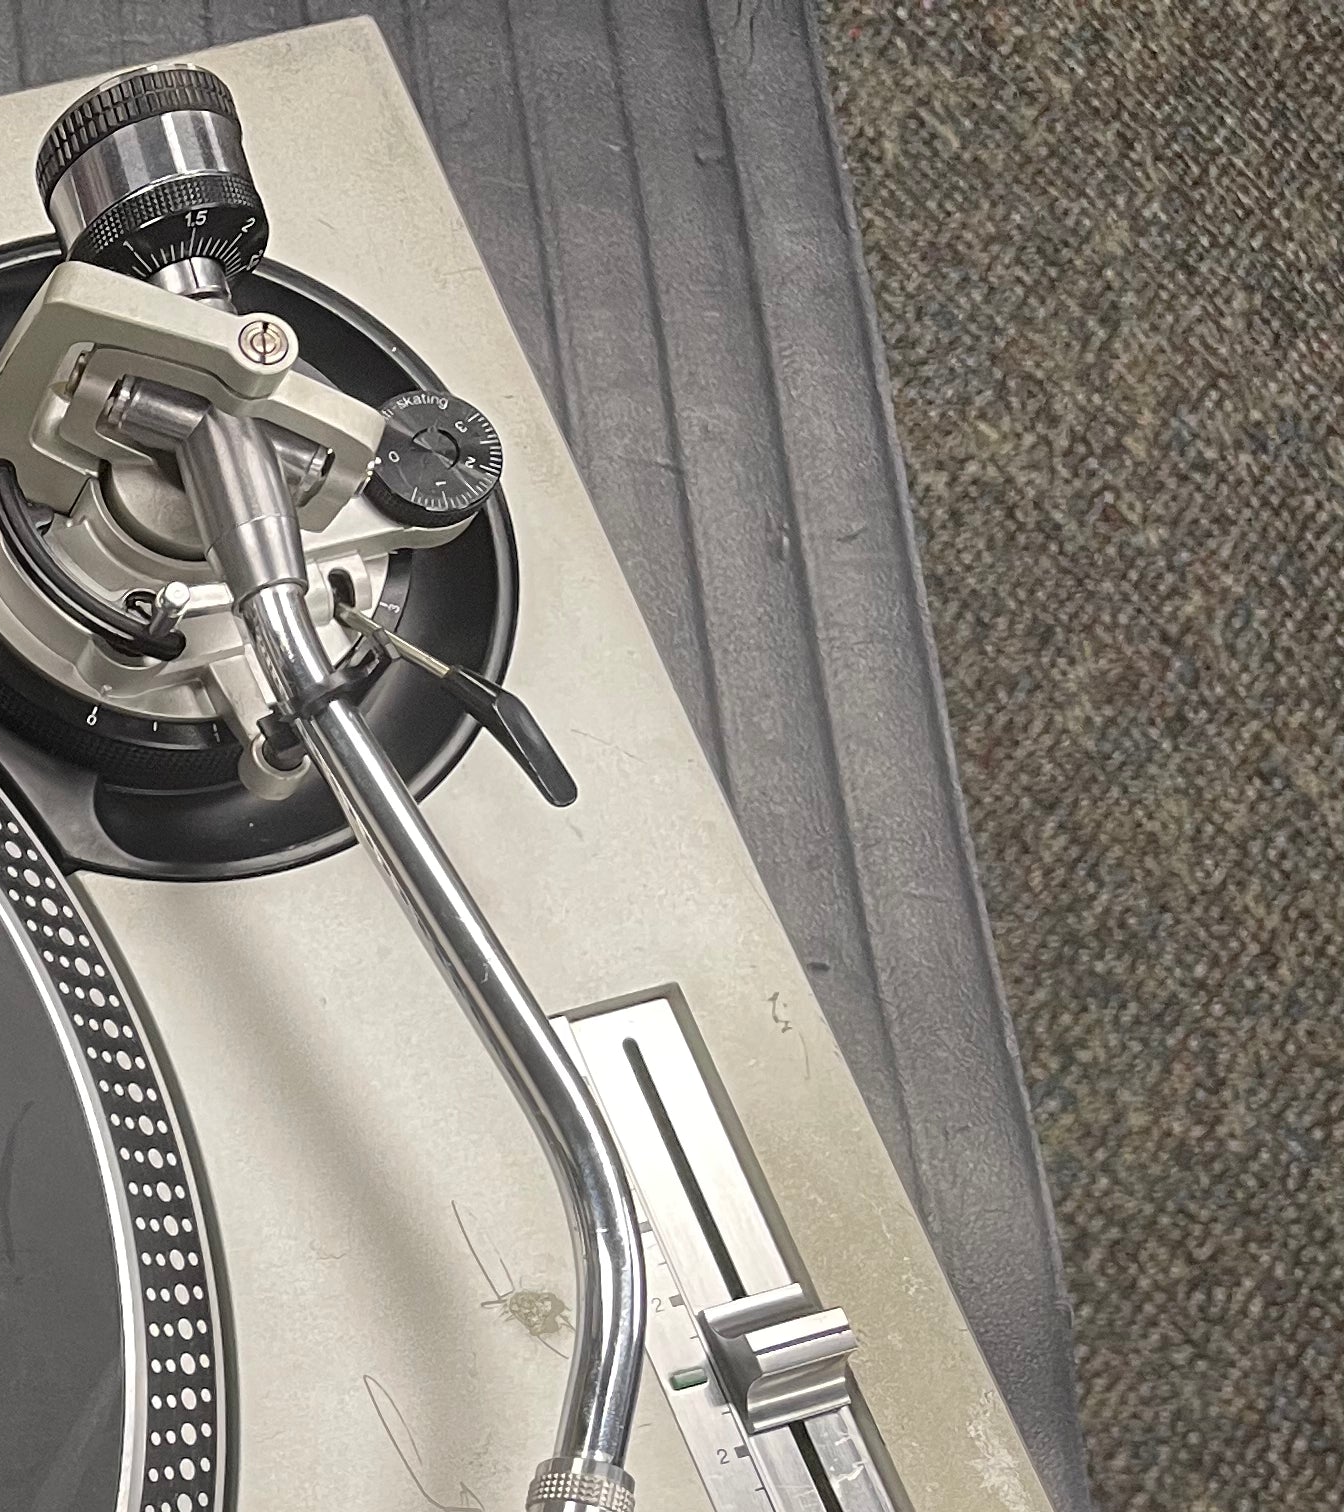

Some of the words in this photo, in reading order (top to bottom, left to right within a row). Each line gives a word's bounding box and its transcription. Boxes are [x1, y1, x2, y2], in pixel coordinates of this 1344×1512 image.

[184, 209, 208, 228] 1.5
[241, 217, 256, 233] 2
[381, 393, 449, 421] ti-skating
[454, 420, 468, 433] 3
[388, 450, 400, 463] 0
[464, 456, 477, 469] 2
[651, 1297, 665, 1313] 2
[716, 1448, 730, 1465] 2
